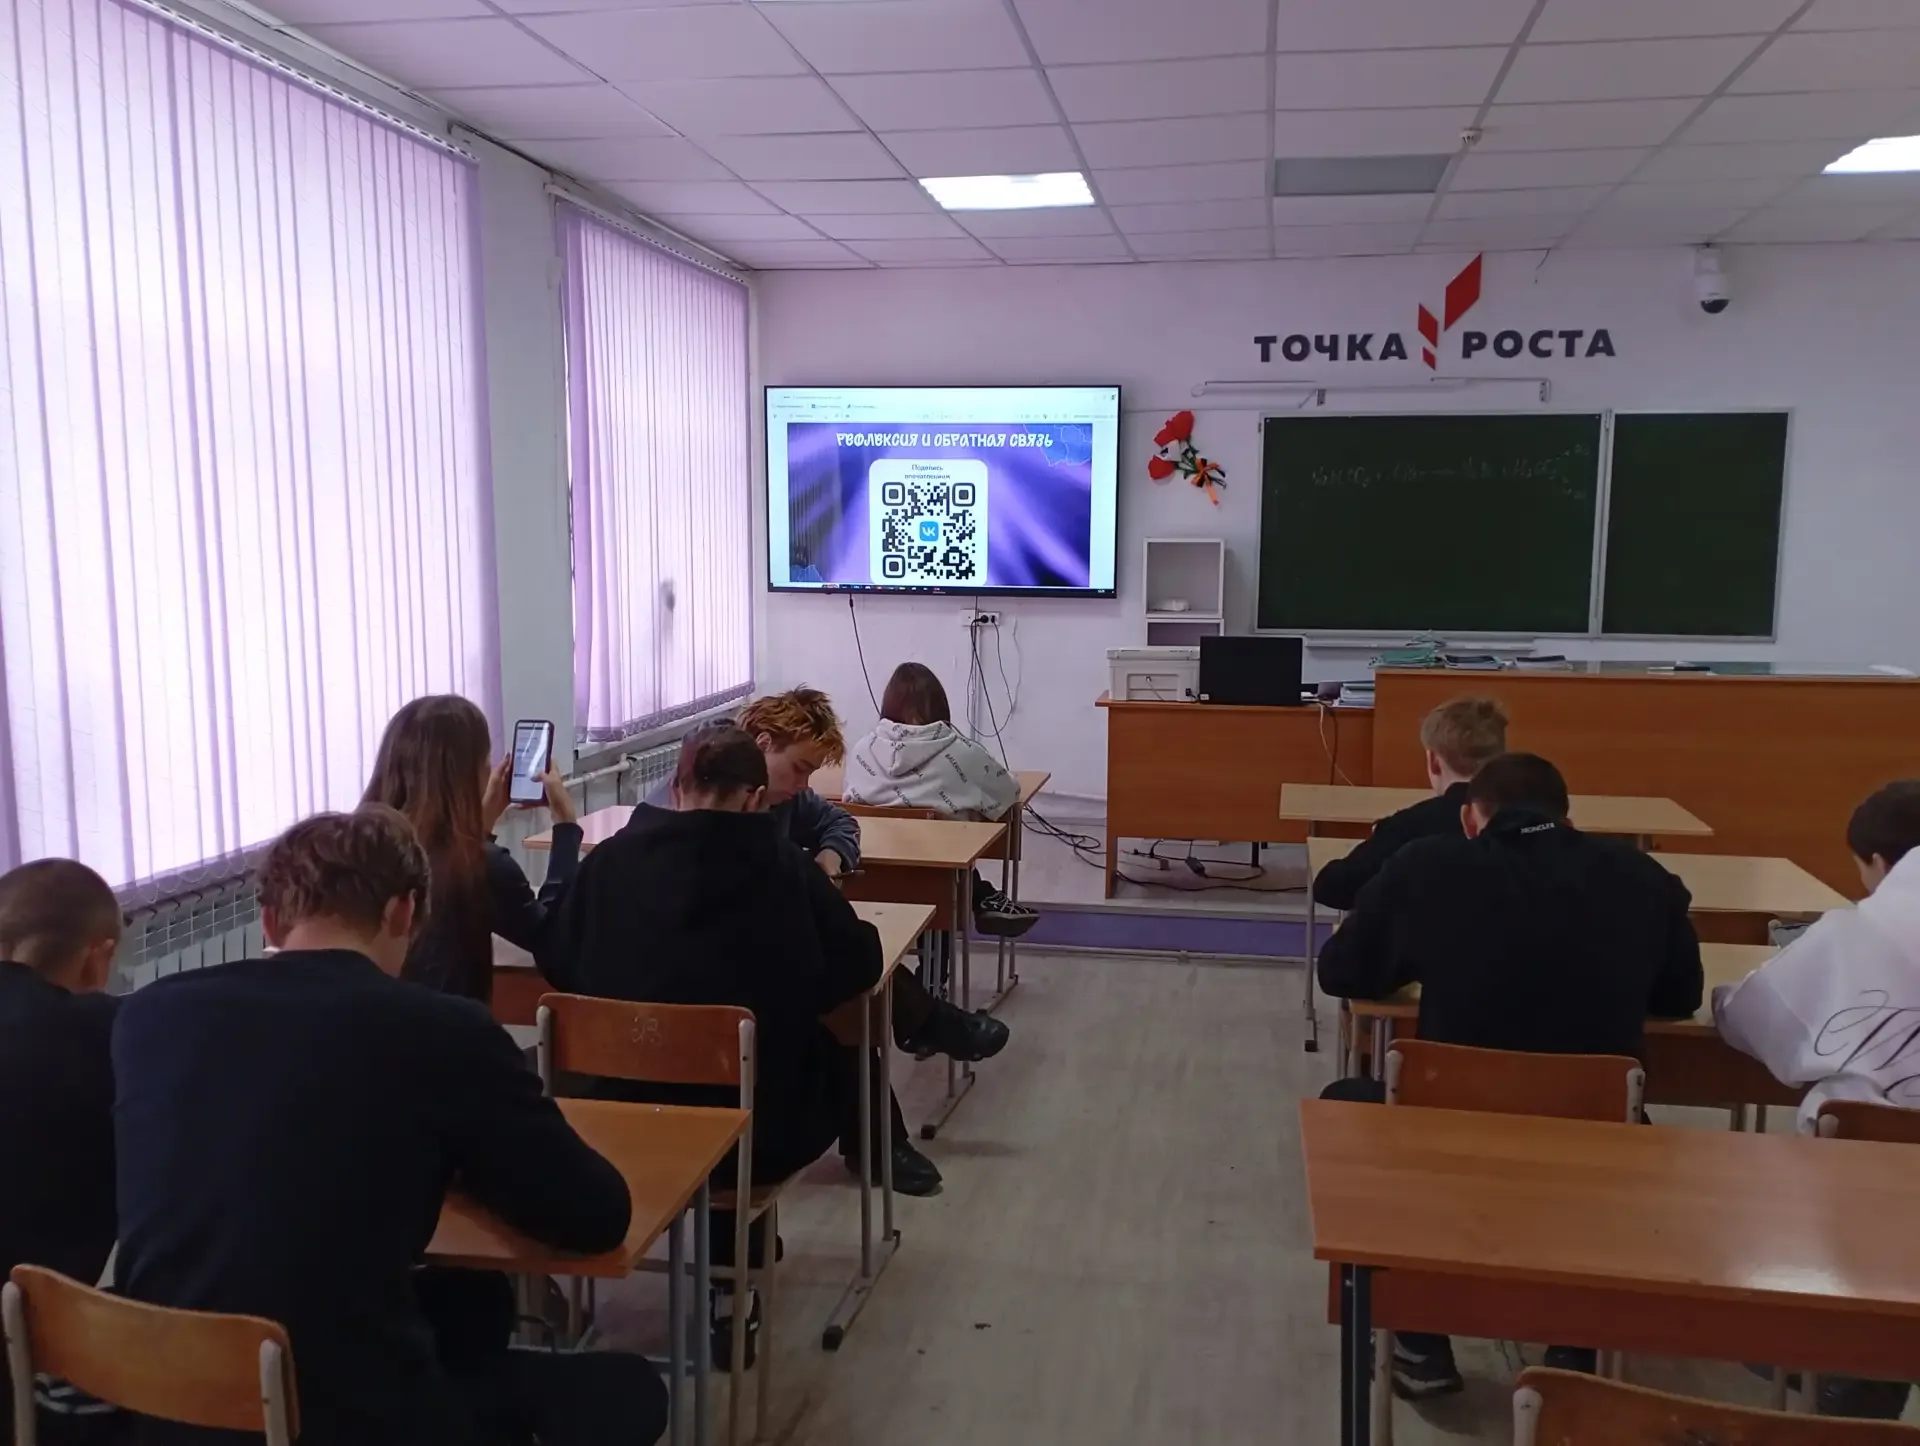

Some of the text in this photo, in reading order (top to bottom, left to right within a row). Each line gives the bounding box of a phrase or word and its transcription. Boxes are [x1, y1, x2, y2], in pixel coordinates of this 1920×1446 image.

[1254, 329, 1616, 363] ТОЧКА РОСТА
[921, 433, 931, 447] И
[934, 433, 1006, 447] ОБРАТНАЯ
[1009, 433, 1054, 447] СВЯЗЬ
